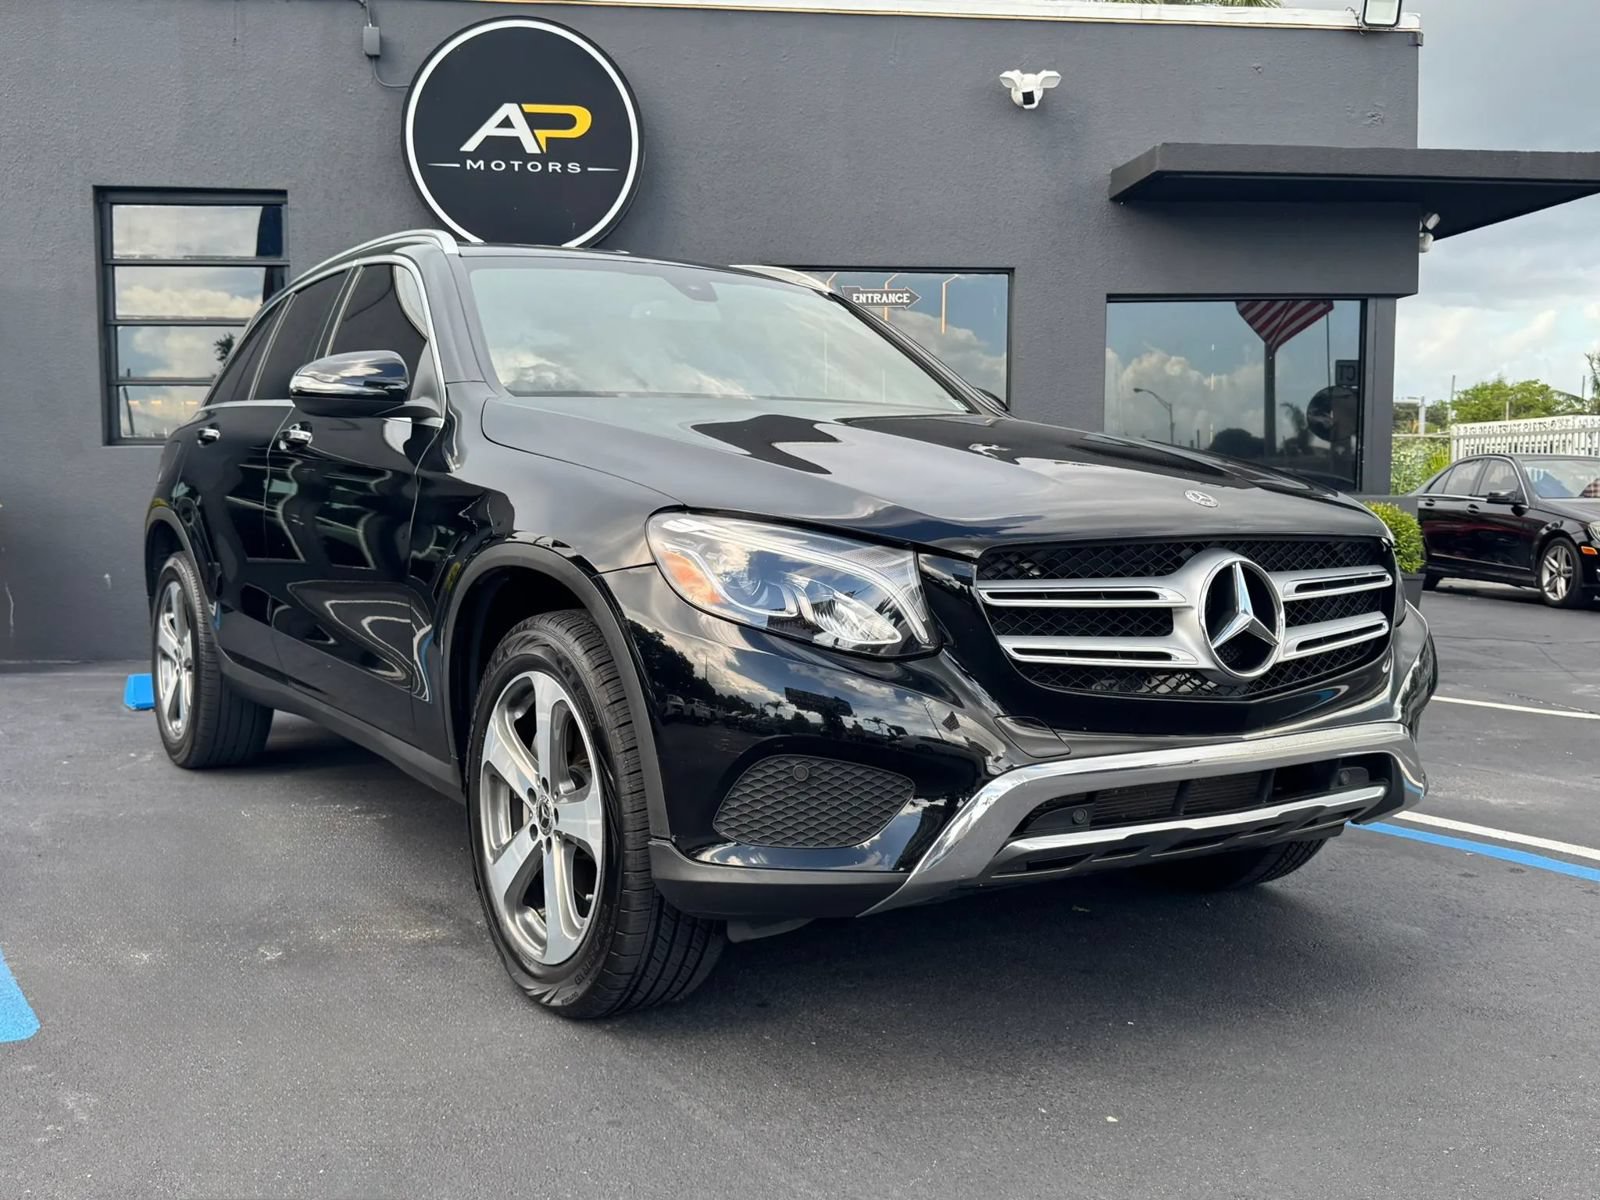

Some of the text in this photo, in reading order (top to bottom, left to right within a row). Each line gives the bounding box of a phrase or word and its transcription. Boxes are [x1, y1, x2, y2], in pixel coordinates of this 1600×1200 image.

[460, 103, 592, 154] AP
[466, 159, 582, 173] MOTORS
[852, 293, 911, 303] ENTRANCE
